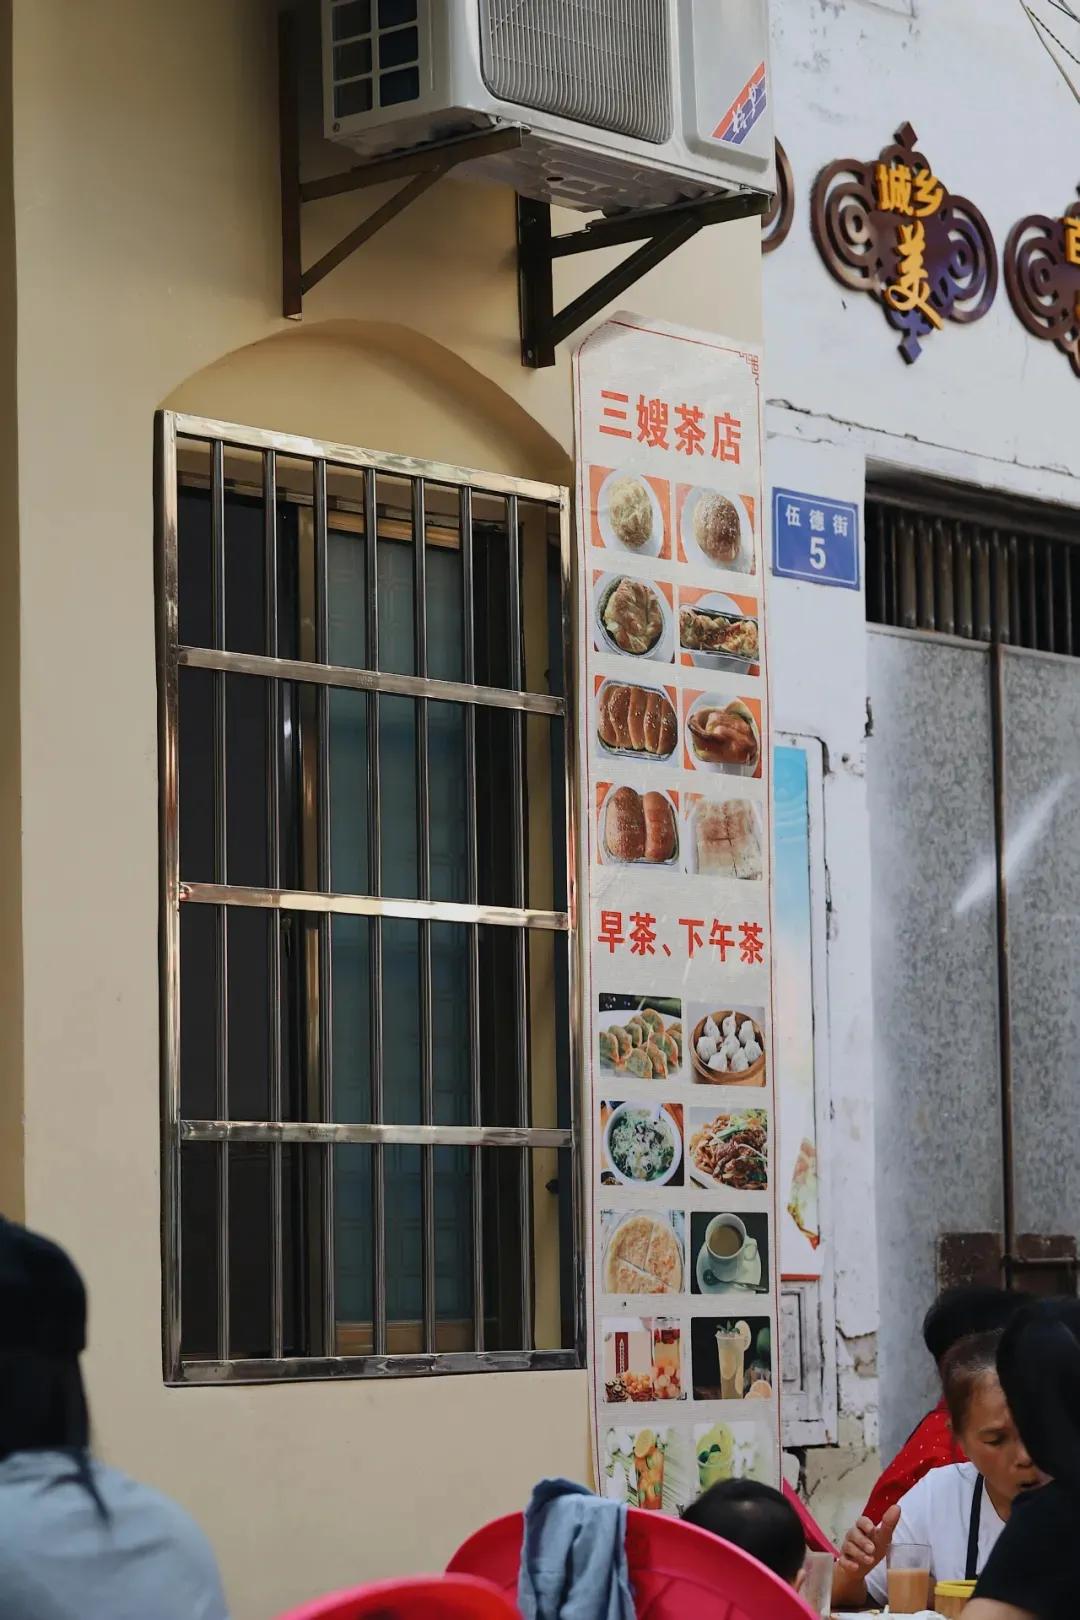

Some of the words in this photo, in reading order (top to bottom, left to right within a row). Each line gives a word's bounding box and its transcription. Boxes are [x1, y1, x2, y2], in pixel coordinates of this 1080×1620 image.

[598, 389, 742, 465] 三嫂茶店
[785, 503, 849, 537] 伍德街
[809, 536, 826, 570] 5
[597, 910, 764, 964] 早茶、下午茶
